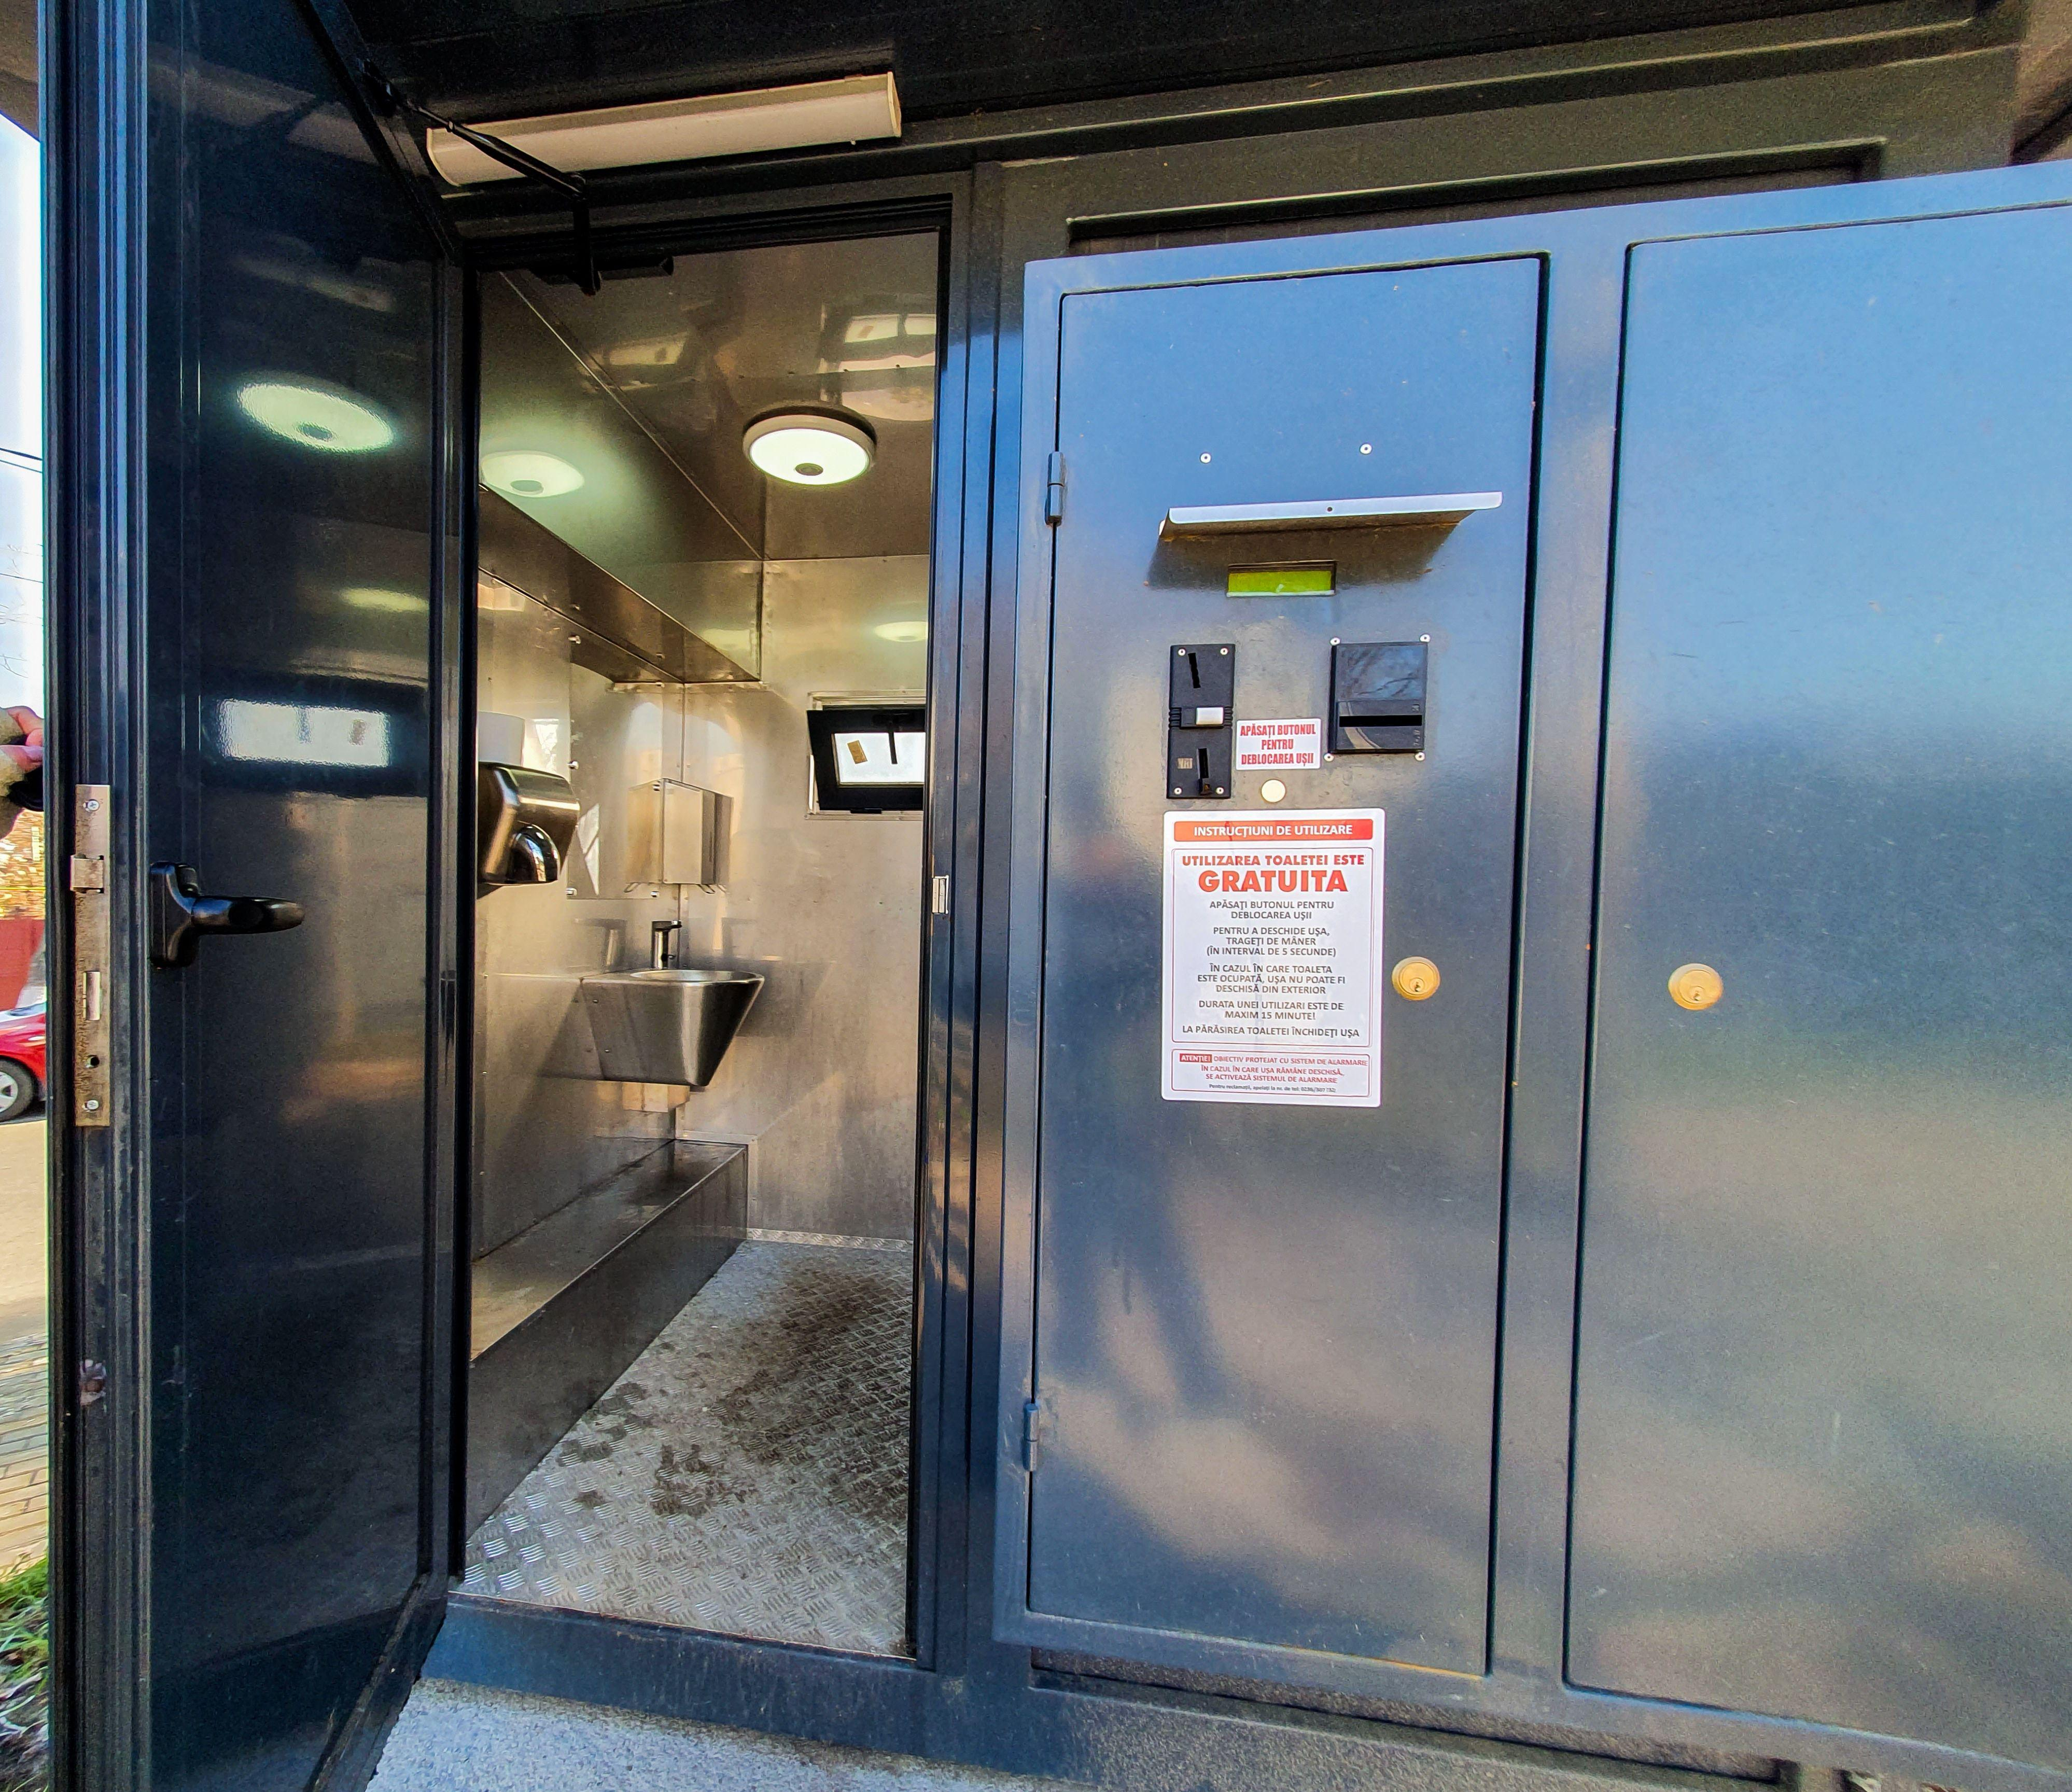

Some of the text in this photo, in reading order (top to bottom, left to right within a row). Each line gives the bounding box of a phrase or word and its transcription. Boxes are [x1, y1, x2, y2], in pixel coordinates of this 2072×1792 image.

[1278, 724, 1316, 735] BUTONUL
[1262, 739, 1294, 750] PENTRU
[1241, 753, 1294, 765] DEBLOCAREA
[1277, 825, 1292, 835] DE
[1295, 825, 1353, 835] UTILIZARE
[1182, 855, 1364, 866] UTILIZAREA TOALETEI ESTE
[1198, 870, 1348, 892] GRATUITA
[1282, 936, 1316, 945] MÂNER
[1207, 945, 1219, 956] (ÎN
[1291, 948, 1336, 957] SECUNDE)
[1210, 963, 1220, 972] ÎN
[1253, 963, 1263, 972] ÎN
[1220, 974, 1264, 984] OCUPATĂ,
[1216, 984, 1259, 993] DESCHISĂ
[1196, 1024, 1244, 1034] PĂRĂSIREA
